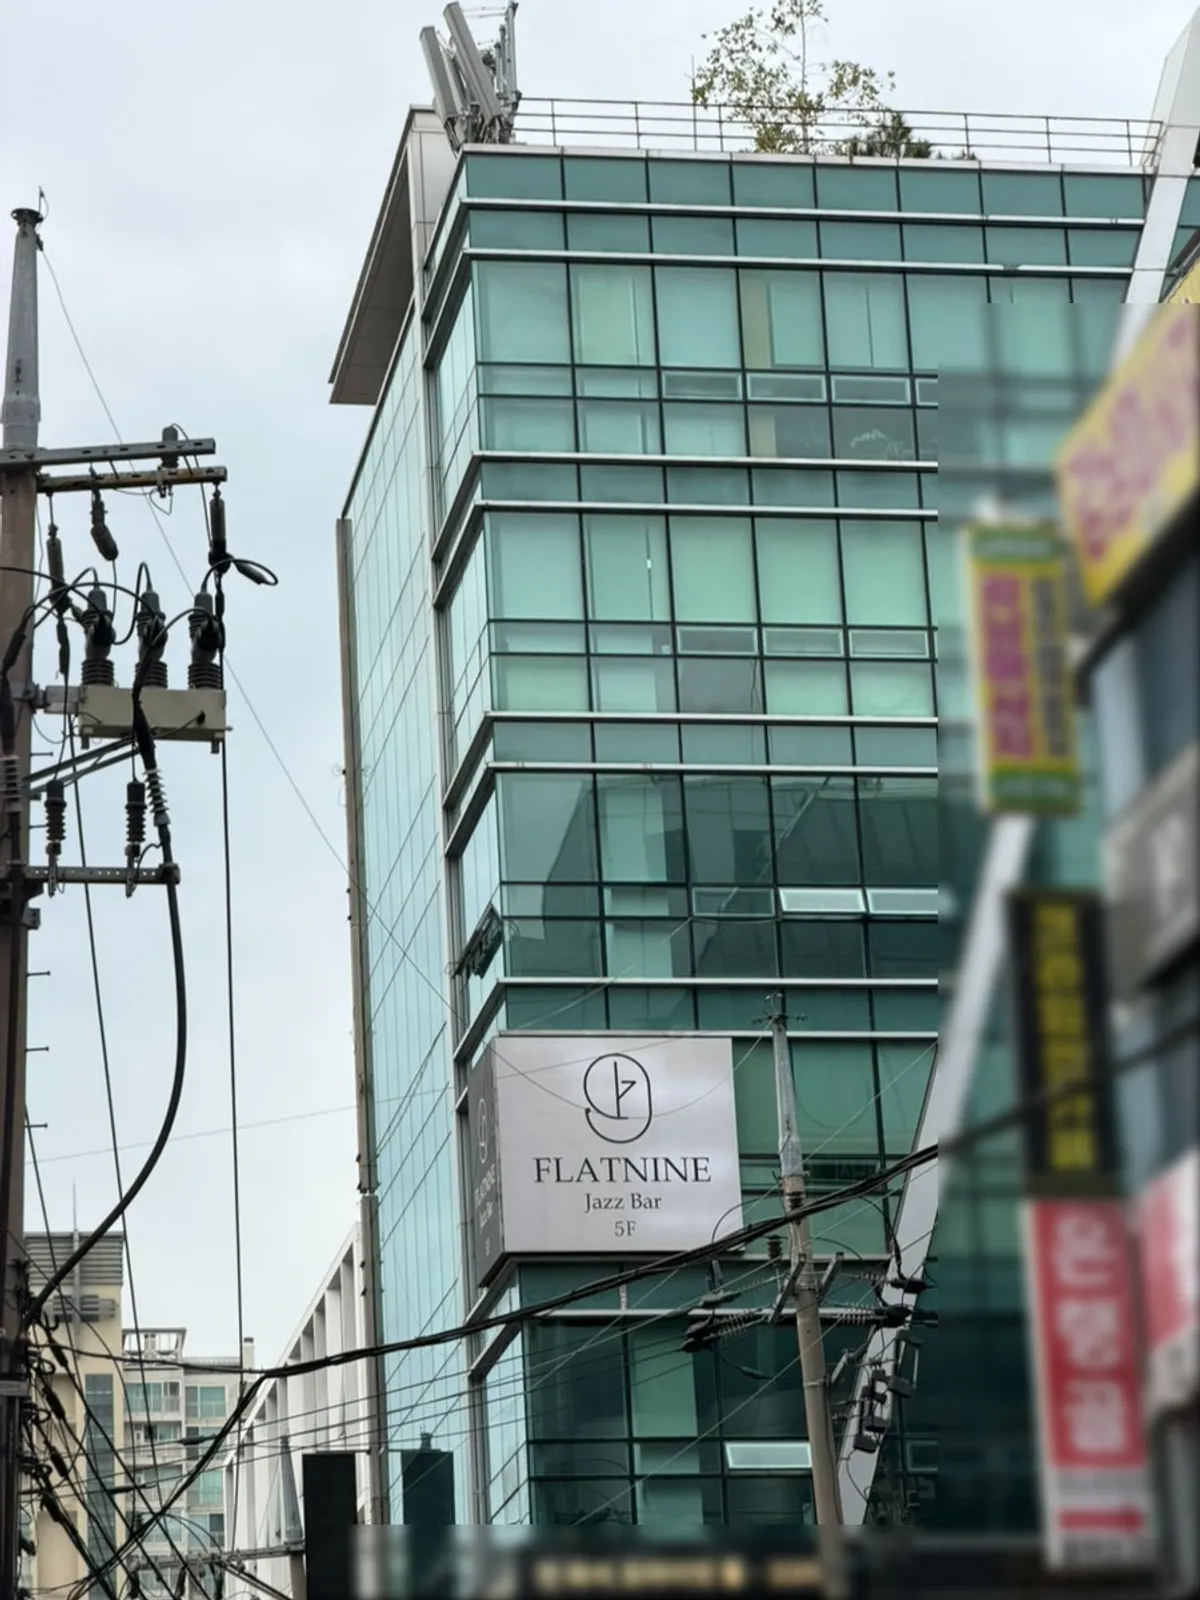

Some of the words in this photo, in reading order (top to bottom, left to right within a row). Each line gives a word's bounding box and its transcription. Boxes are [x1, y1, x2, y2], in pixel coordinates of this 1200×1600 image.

[532, 1156, 712, 1184] FLATNINE
[584, 1192, 625, 1214] Jazz
[630, 1192, 663, 1210] Bar
[614, 1220, 637, 1237] 5F
